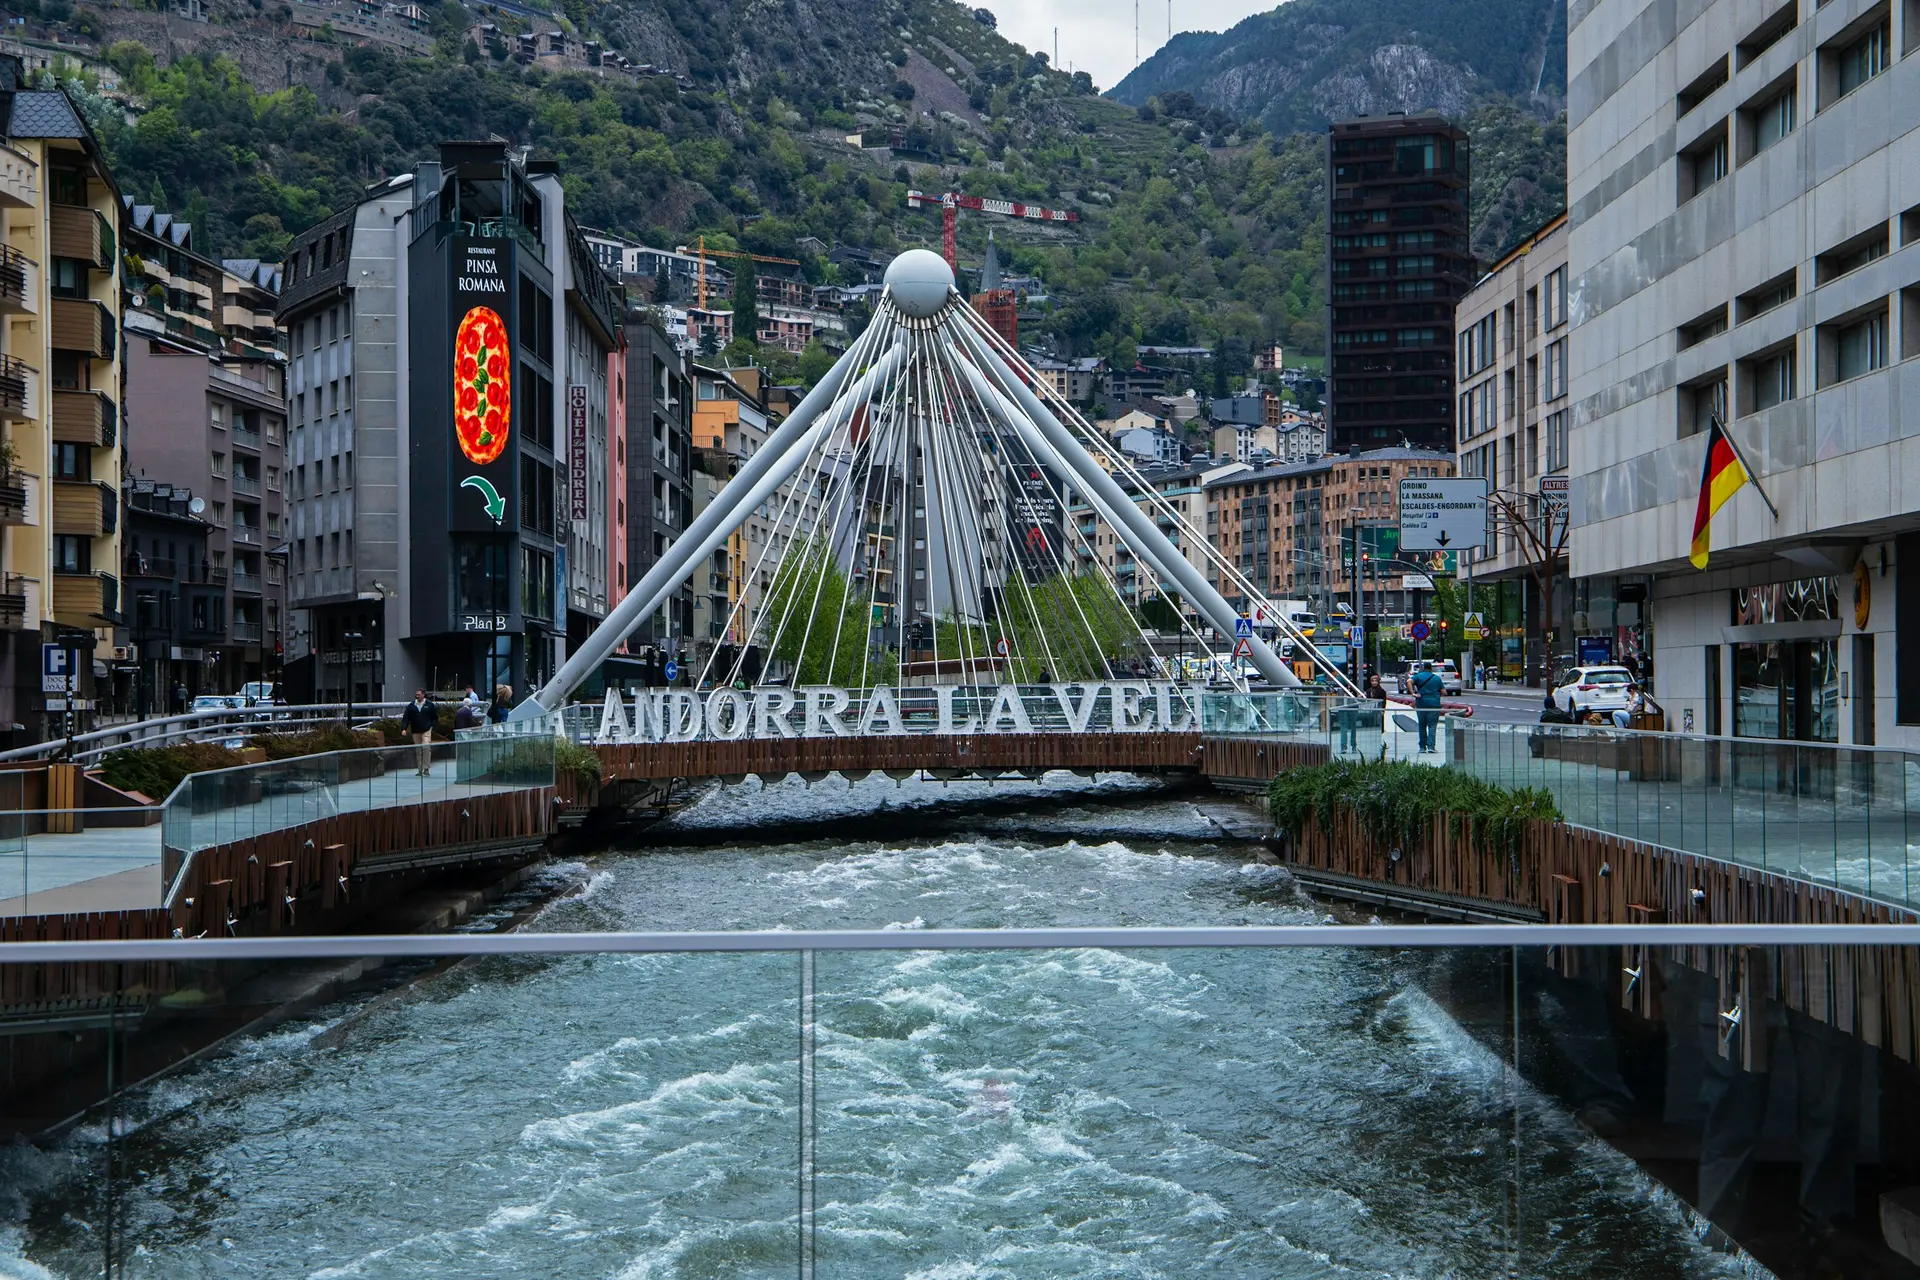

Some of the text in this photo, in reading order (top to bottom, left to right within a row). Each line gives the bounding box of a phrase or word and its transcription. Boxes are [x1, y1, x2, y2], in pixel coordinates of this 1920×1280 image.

[466, 259, 498, 273] PINSA
[459, 277, 506, 292] ROMANA
[573, 387, 586, 437] HOTEL
[573, 449, 586, 519] PEDRERA
[463, 615, 506, 630] Plan B
[596, 684, 908, 745] ANDORRA
[931, 683, 1036, 735] LA
